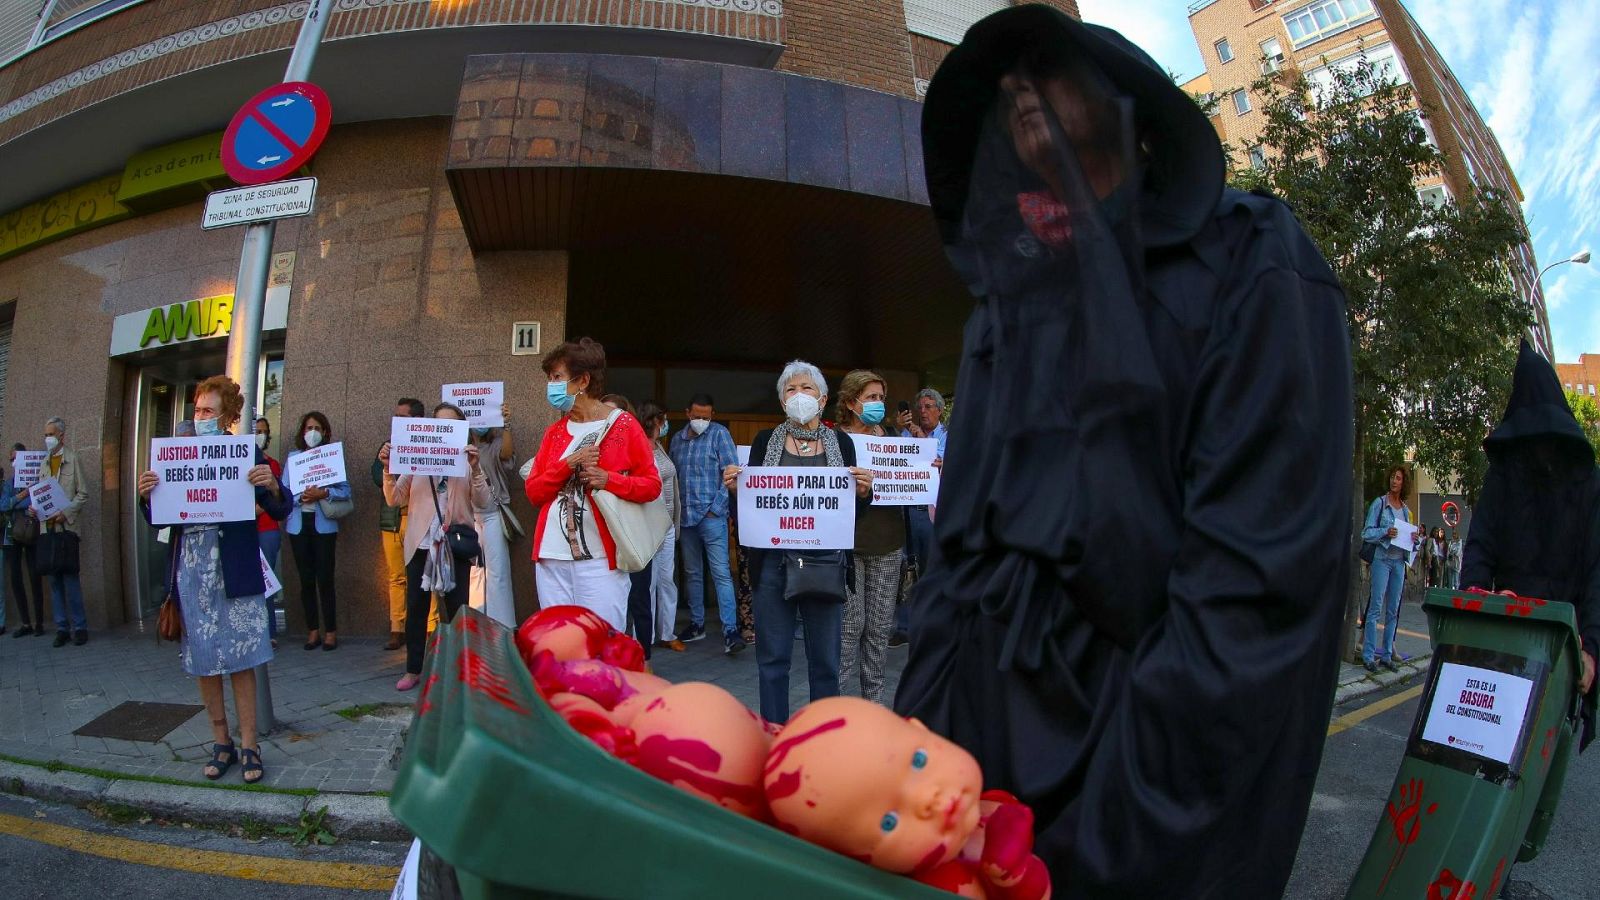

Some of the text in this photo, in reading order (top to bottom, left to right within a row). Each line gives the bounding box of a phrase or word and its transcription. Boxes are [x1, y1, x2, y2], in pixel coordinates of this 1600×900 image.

[223, 185, 299, 205] ZONA DE SEGURIDAD
[208, 200, 309, 223] TRIBUNAL CONSTITUCIONAL
[140, 295, 234, 347] AMIR
[518, 328, 533, 348] 11
[452, 387, 493, 397] MAGISTRADOS:
[457, 397, 485, 407] DÉJENLOS
[435, 424, 454, 433] BEBÉS
[157, 443, 249, 461] JUSTICIA PARA LOS
[396, 445, 460, 455] ESPERANDO SENTENCIA
[899, 443, 920, 455] BEBÉS
[399, 456, 456, 467] DEL CONSTITUCIONAL
[165, 463, 239, 482] BEBÉS AÚN POR
[867, 469, 931, 480] RANDO SENTENCIA
[745, 475, 849, 489] JUSTICIA PARA LOS
[873, 483, 928, 493] CONSTITUCIONAL
[186, 488, 218, 503] NACER
[756, 492, 839, 510] BEBÉS AÚN POR
[779, 516, 815, 530] NACER
[1466, 678, 1497, 693] ESTA ES LA
[1459, 689, 1495, 710] BASURA
[1446, 704, 1502, 725] DEL CONSTITUCIONAL
